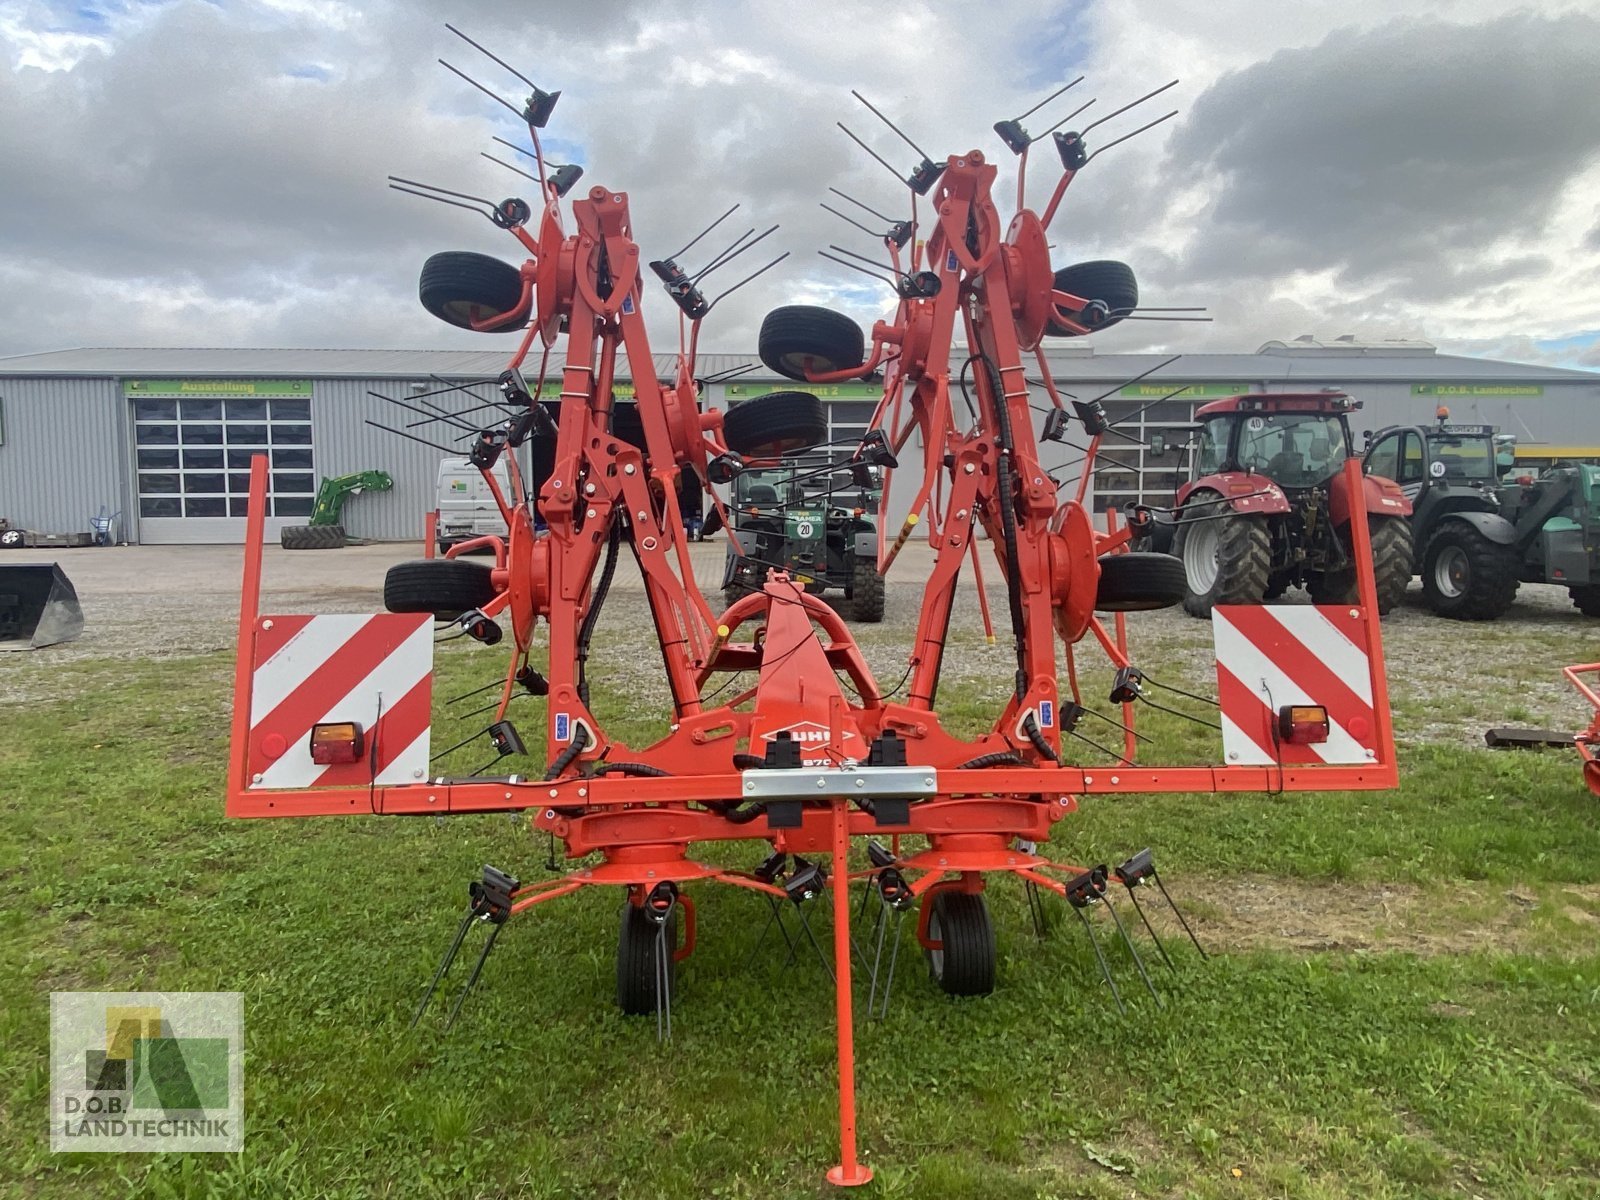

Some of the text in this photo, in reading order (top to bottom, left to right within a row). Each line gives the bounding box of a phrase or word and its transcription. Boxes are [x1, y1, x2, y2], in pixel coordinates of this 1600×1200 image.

[180, 382, 255, 396] Ausstellung
[831, 386, 839, 395] 2
[1472, 385, 1539, 395] Landtechnik
[1250, 418, 1261, 429] 40
[1433, 464, 1443, 474] 40
[800, 524, 810, 535] 20
[792, 731, 830, 741] UH
